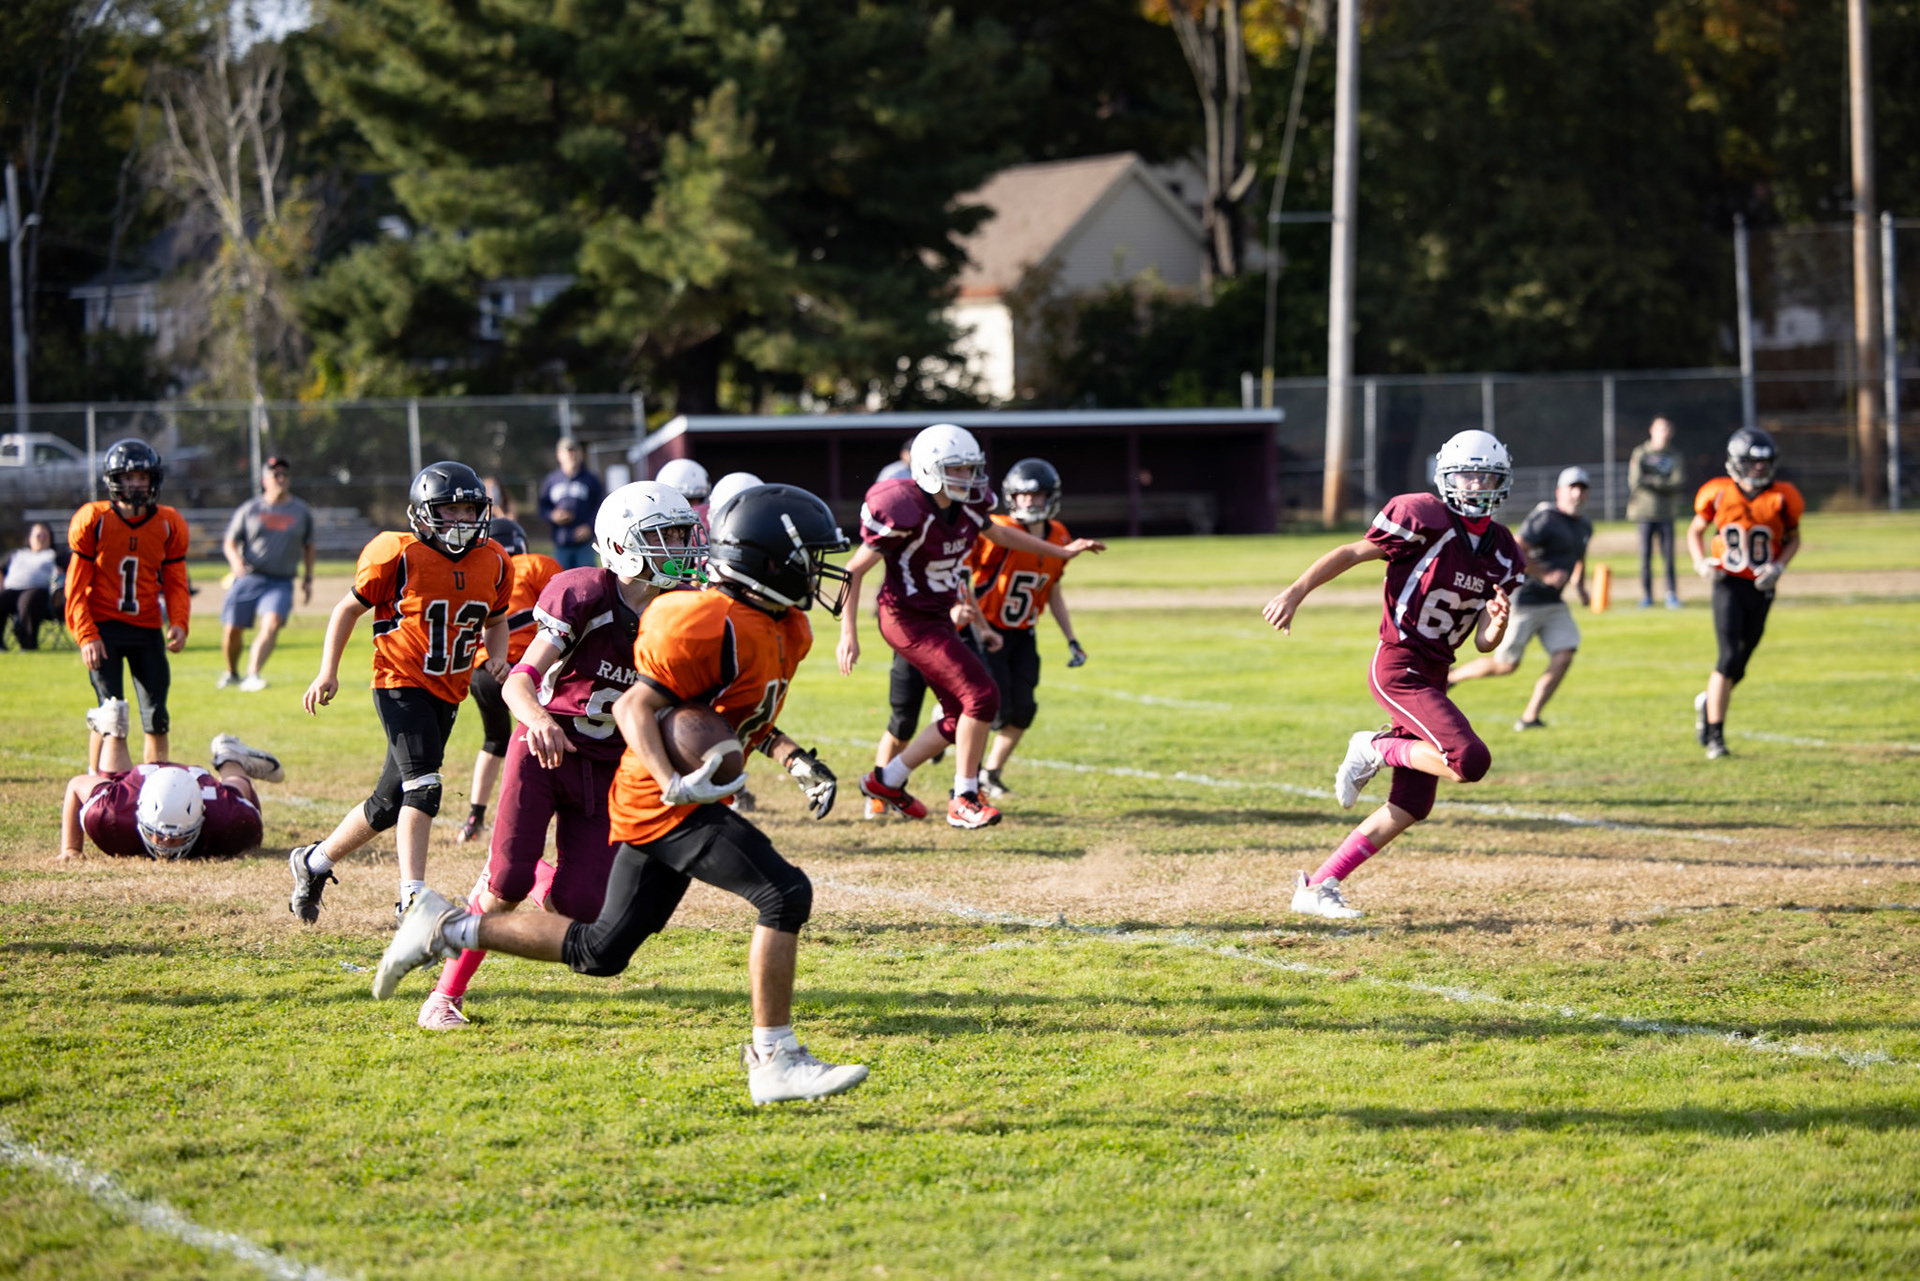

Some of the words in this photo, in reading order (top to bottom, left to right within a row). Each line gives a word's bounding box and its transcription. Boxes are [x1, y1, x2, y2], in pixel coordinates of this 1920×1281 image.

[1720, 523, 1774, 573] 80
[117, 555, 140, 616] 1
[453, 571, 465, 590] U
[1453, 571, 1485, 593] RAMS
[423, 600, 490, 676] 12
[1417, 588, 1486, 646] 63
[735, 678, 789, 749] 1
